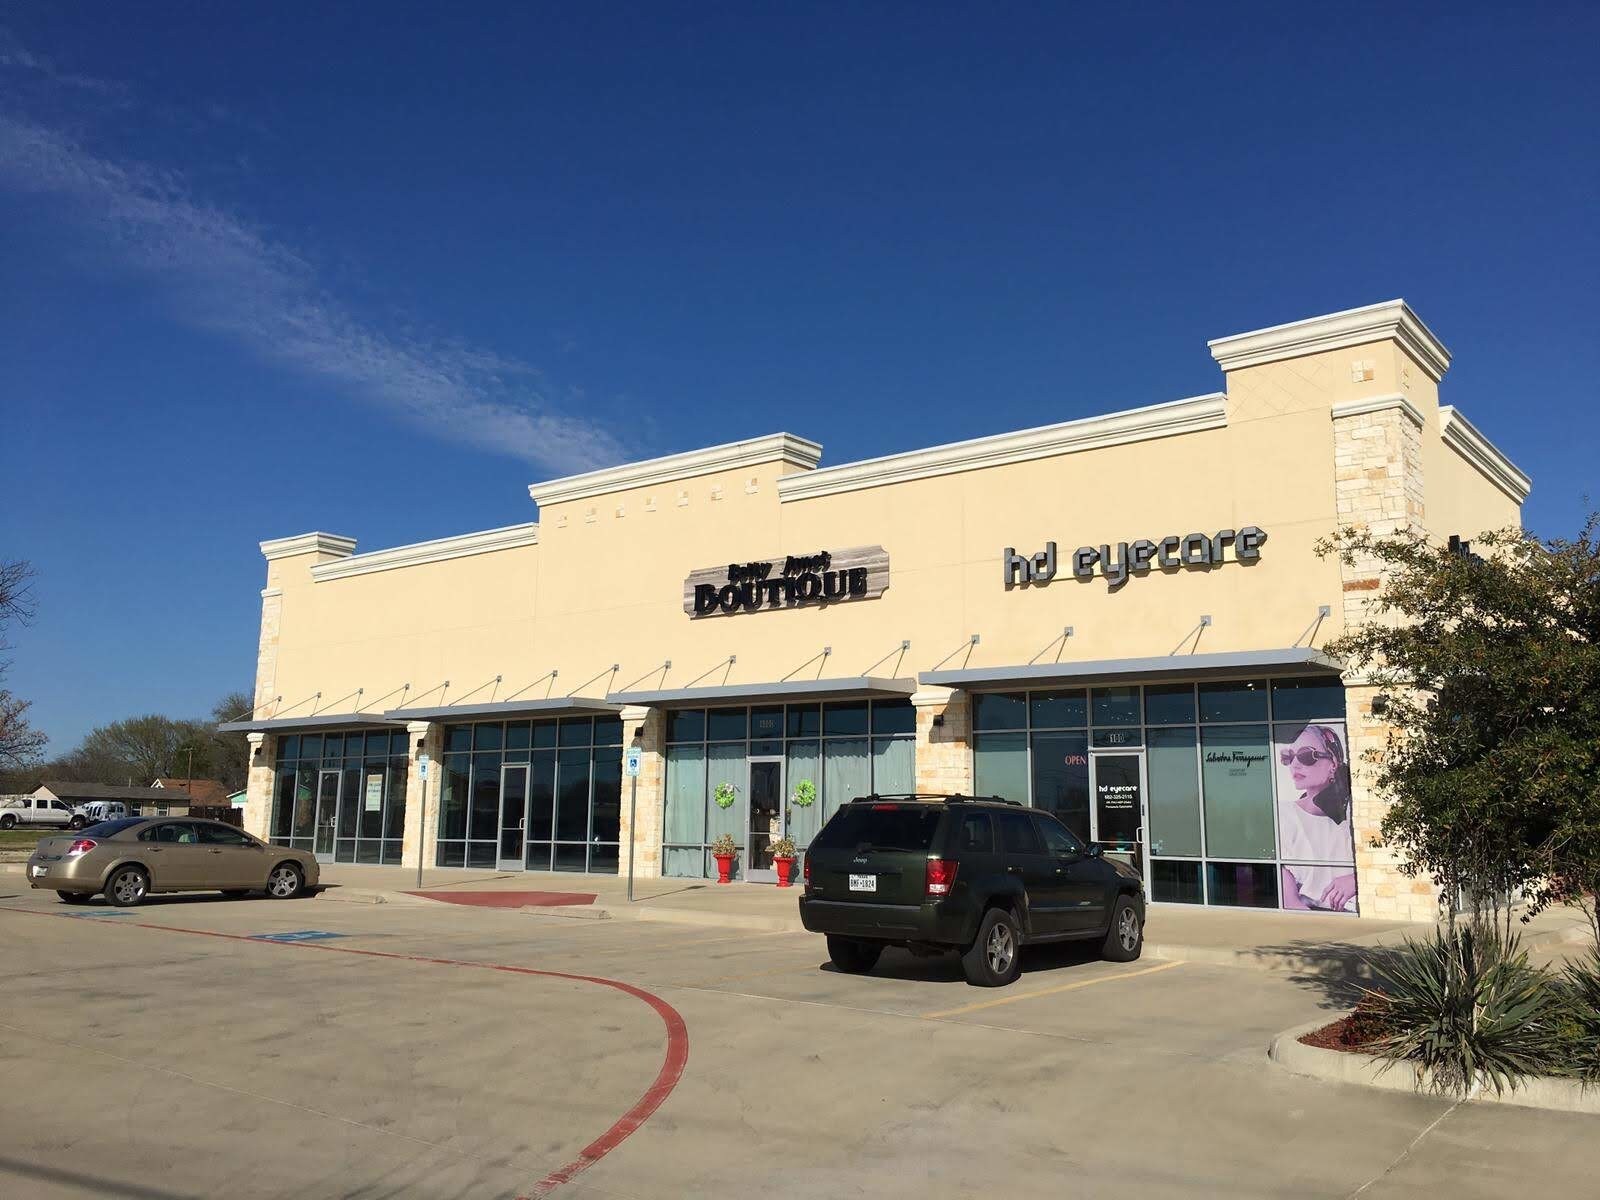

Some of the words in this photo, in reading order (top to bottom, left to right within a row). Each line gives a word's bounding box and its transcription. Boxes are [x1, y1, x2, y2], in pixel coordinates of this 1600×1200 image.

[1004, 541, 1057, 588] hd
[1072, 525, 1268, 594] eyecare
[694, 566, 868, 616] BOUTIQUE
[1065, 755, 1087, 766] OPEN
[1110, 785, 1138, 794] eyecare
